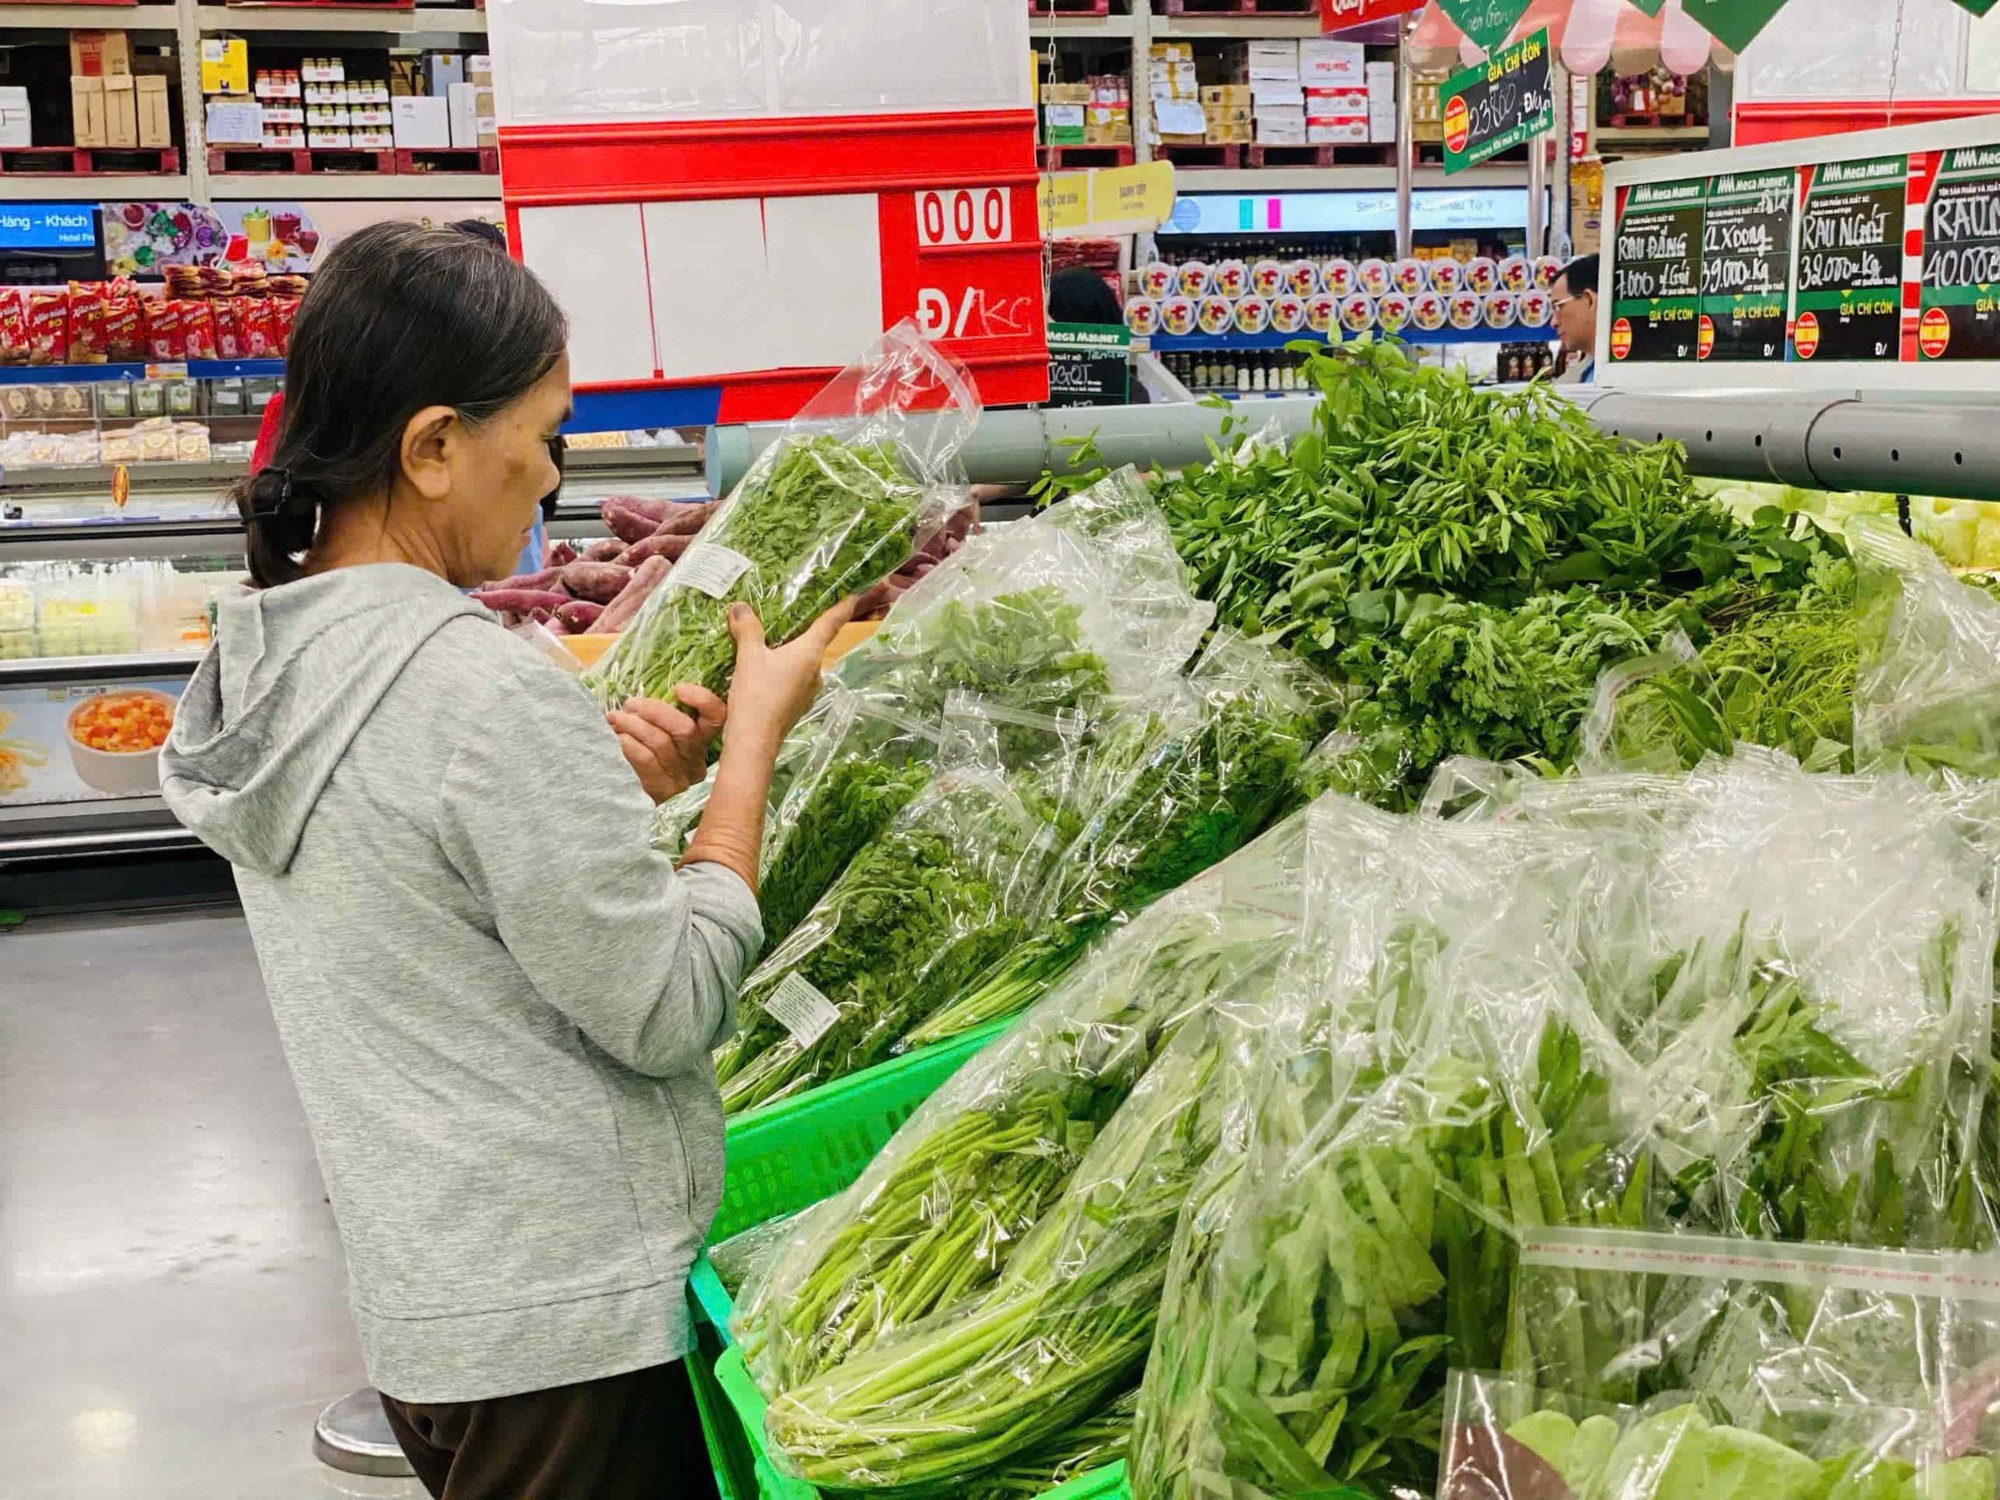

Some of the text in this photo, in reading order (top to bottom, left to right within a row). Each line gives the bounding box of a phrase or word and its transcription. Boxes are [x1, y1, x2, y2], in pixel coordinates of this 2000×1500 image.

[1843, 168, 1865, 180] Mega
[1866, 163, 1899, 179] Market
[923, 188, 1003, 243] 000
[1801, 215, 1836, 250] RAU
[1618, 236, 1644, 261] RAU
[1840, 298, 1893, 316] GIÁ CHỈ CÒN
[1976, 296, 1993, 312] GIÁ
[1077, 332, 1119, 344] Market
